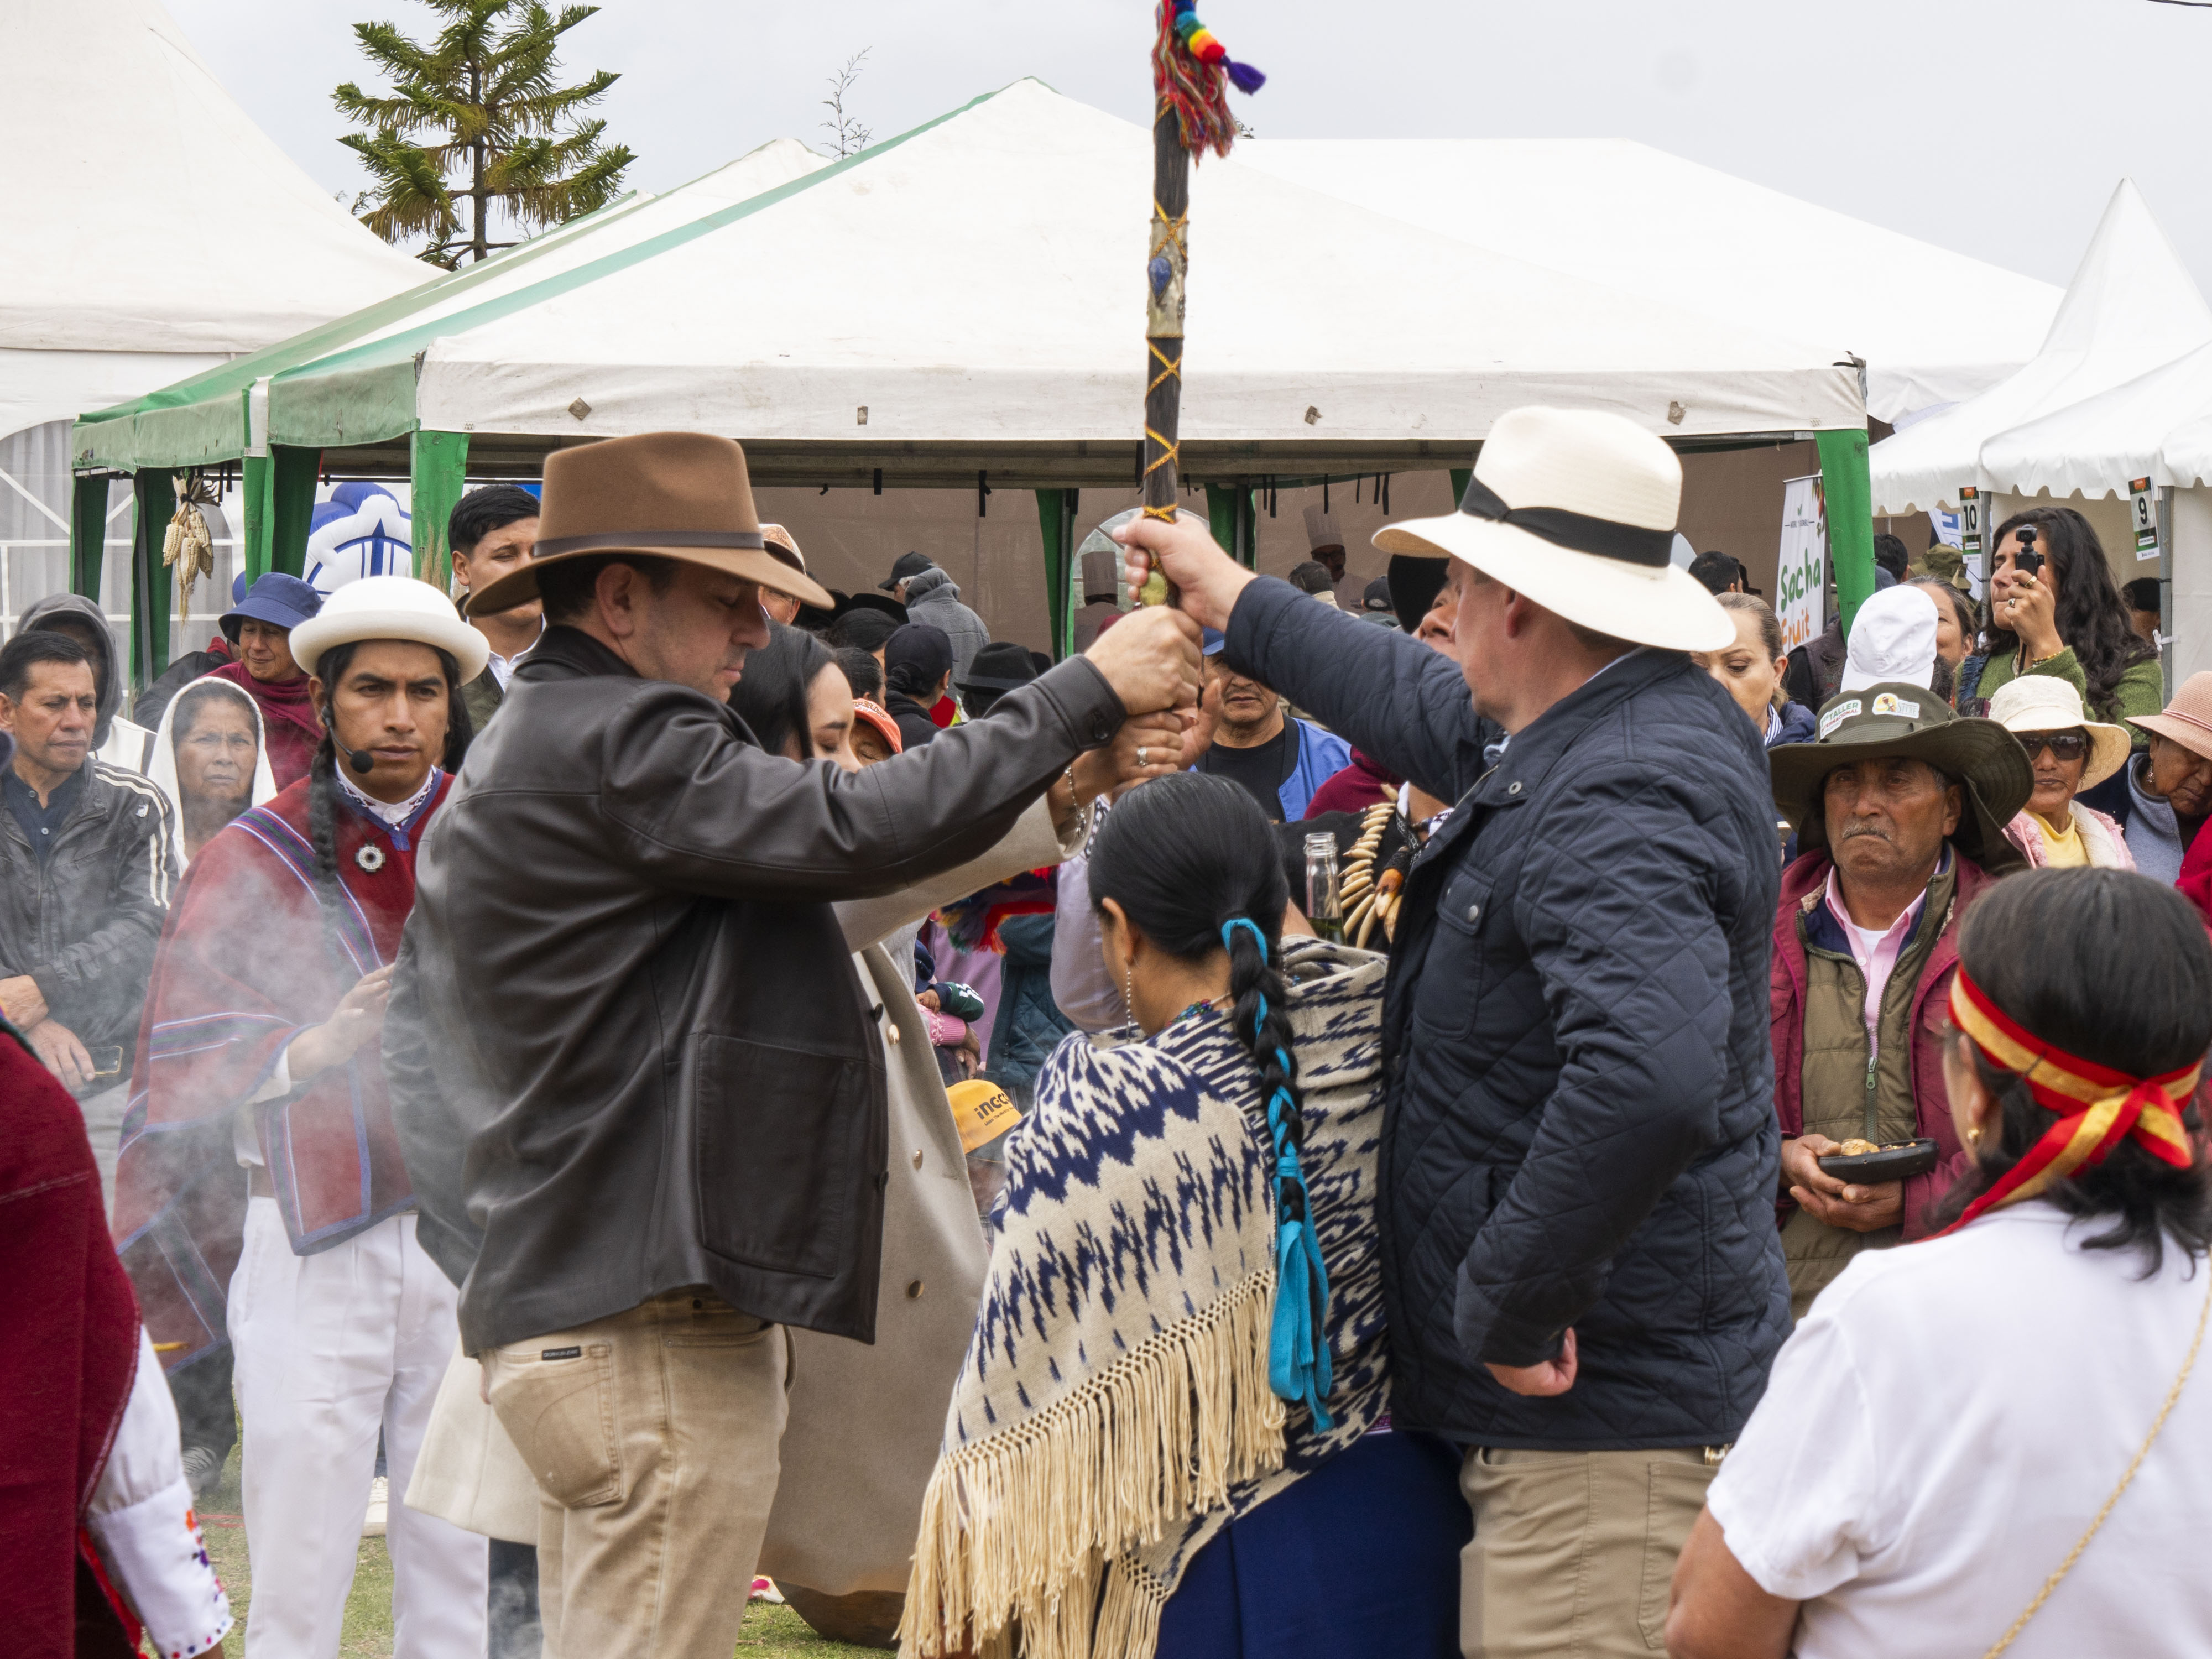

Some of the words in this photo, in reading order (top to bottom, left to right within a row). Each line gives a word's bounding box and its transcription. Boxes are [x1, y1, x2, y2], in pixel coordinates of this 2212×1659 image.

[1963, 504, 1977, 531] 10
[2138, 497, 2147, 525] 9
[1781, 547, 1821, 613] Sacha
[1781, 607, 1810, 651] Fruit
[1829, 702, 1859, 721] TALLER
